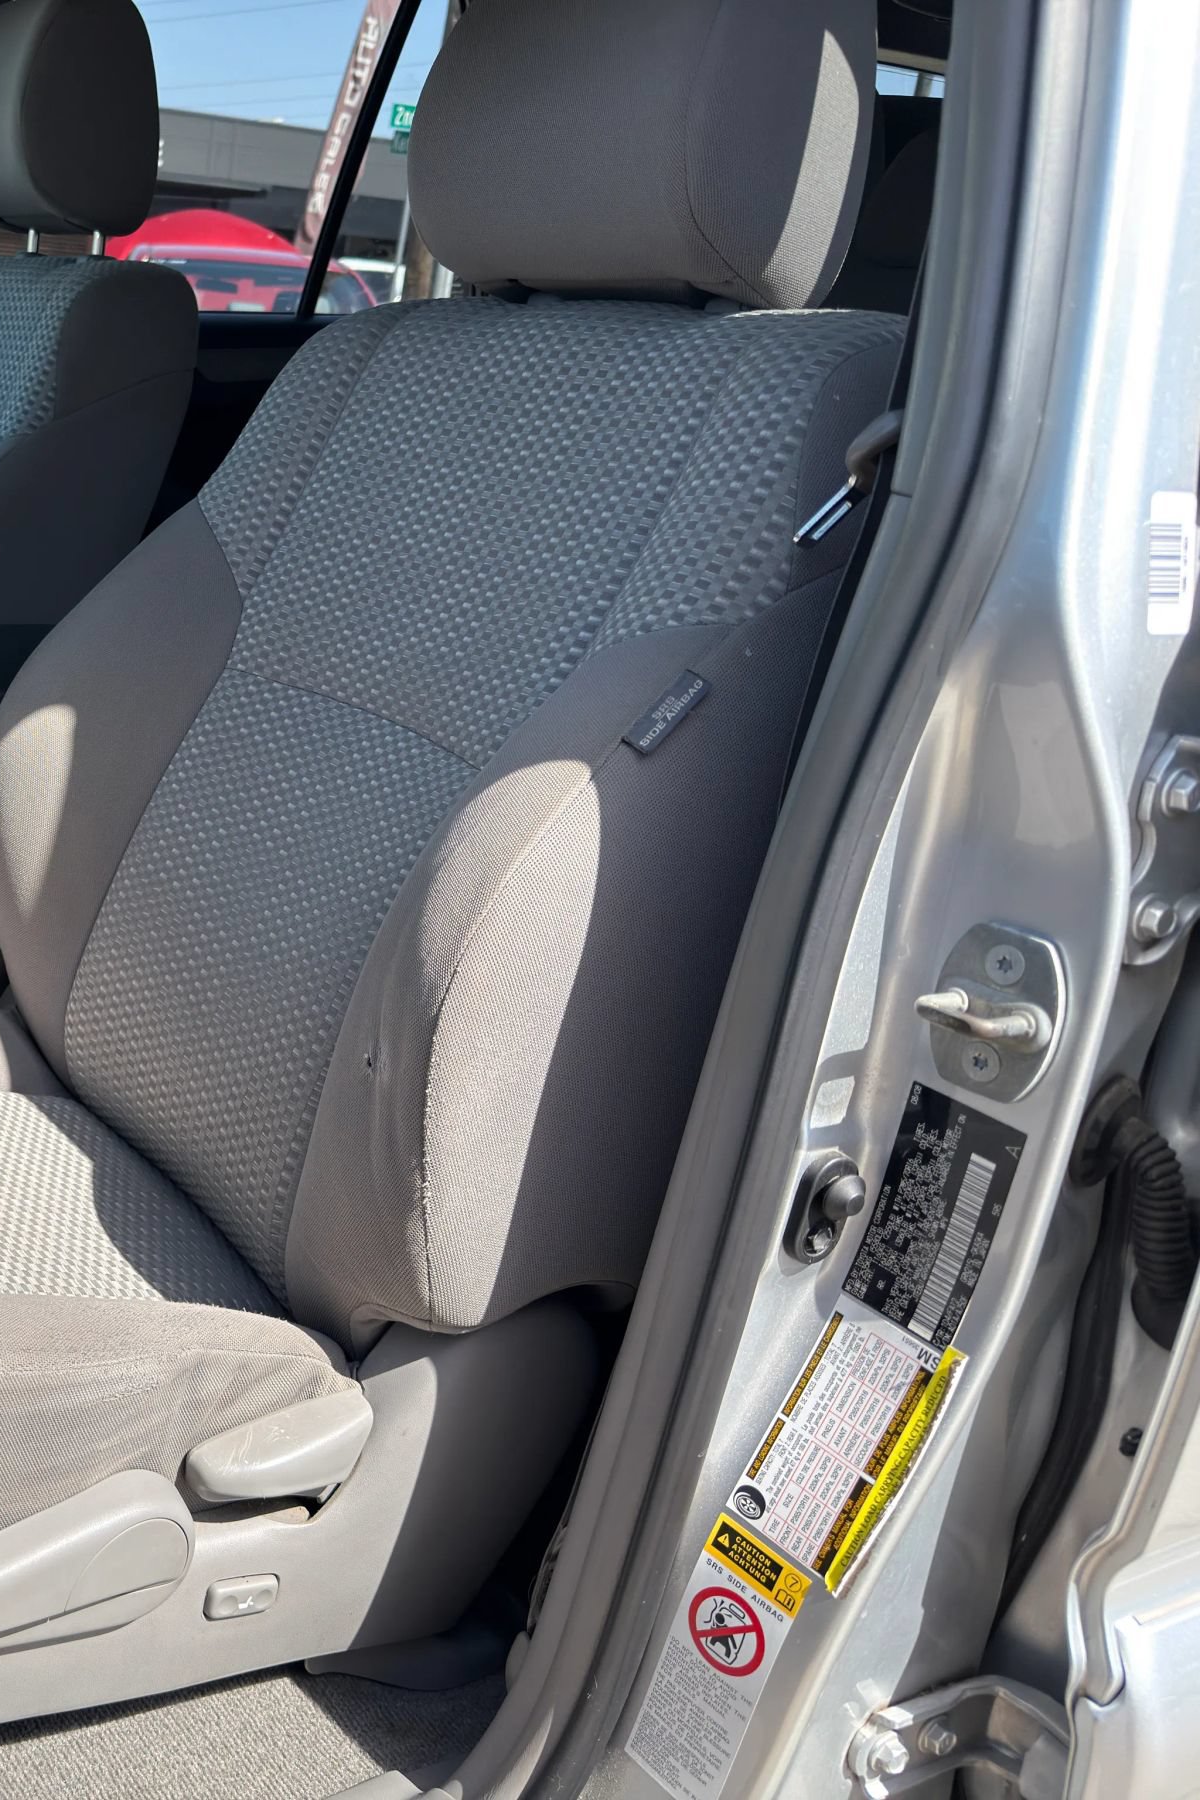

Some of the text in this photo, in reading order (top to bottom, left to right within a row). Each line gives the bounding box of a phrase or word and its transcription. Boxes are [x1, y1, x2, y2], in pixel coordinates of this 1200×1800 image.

[394, 106, 414, 126] 2n
[640, 680, 703, 746] SIDE AIRBAG
[652, 696, 675, 719] SRS
[1002, 1140, 1022, 1159] A
[835, 1380, 856, 1413] DIMENSION
[853, 1438, 872, 1467] SECOURS
[838, 1527, 866, 1568] CAUTION
[859, 1502, 879, 1529] LOAD
[872, 1457, 904, 1504] CARRYING
[897, 1415, 927, 1459] CAPACITY
[920, 1373, 949, 1416] REDUCED
[831, 1511, 847, 1534] MANUAL
[727, 1549, 767, 1583] ACHTUNG
[731, 1542, 777, 1581] ATTENTION
[734, 1535, 771, 1567] CAUTION
[705, 1556, 784, 1623] SRS SIDE AIRBAG
